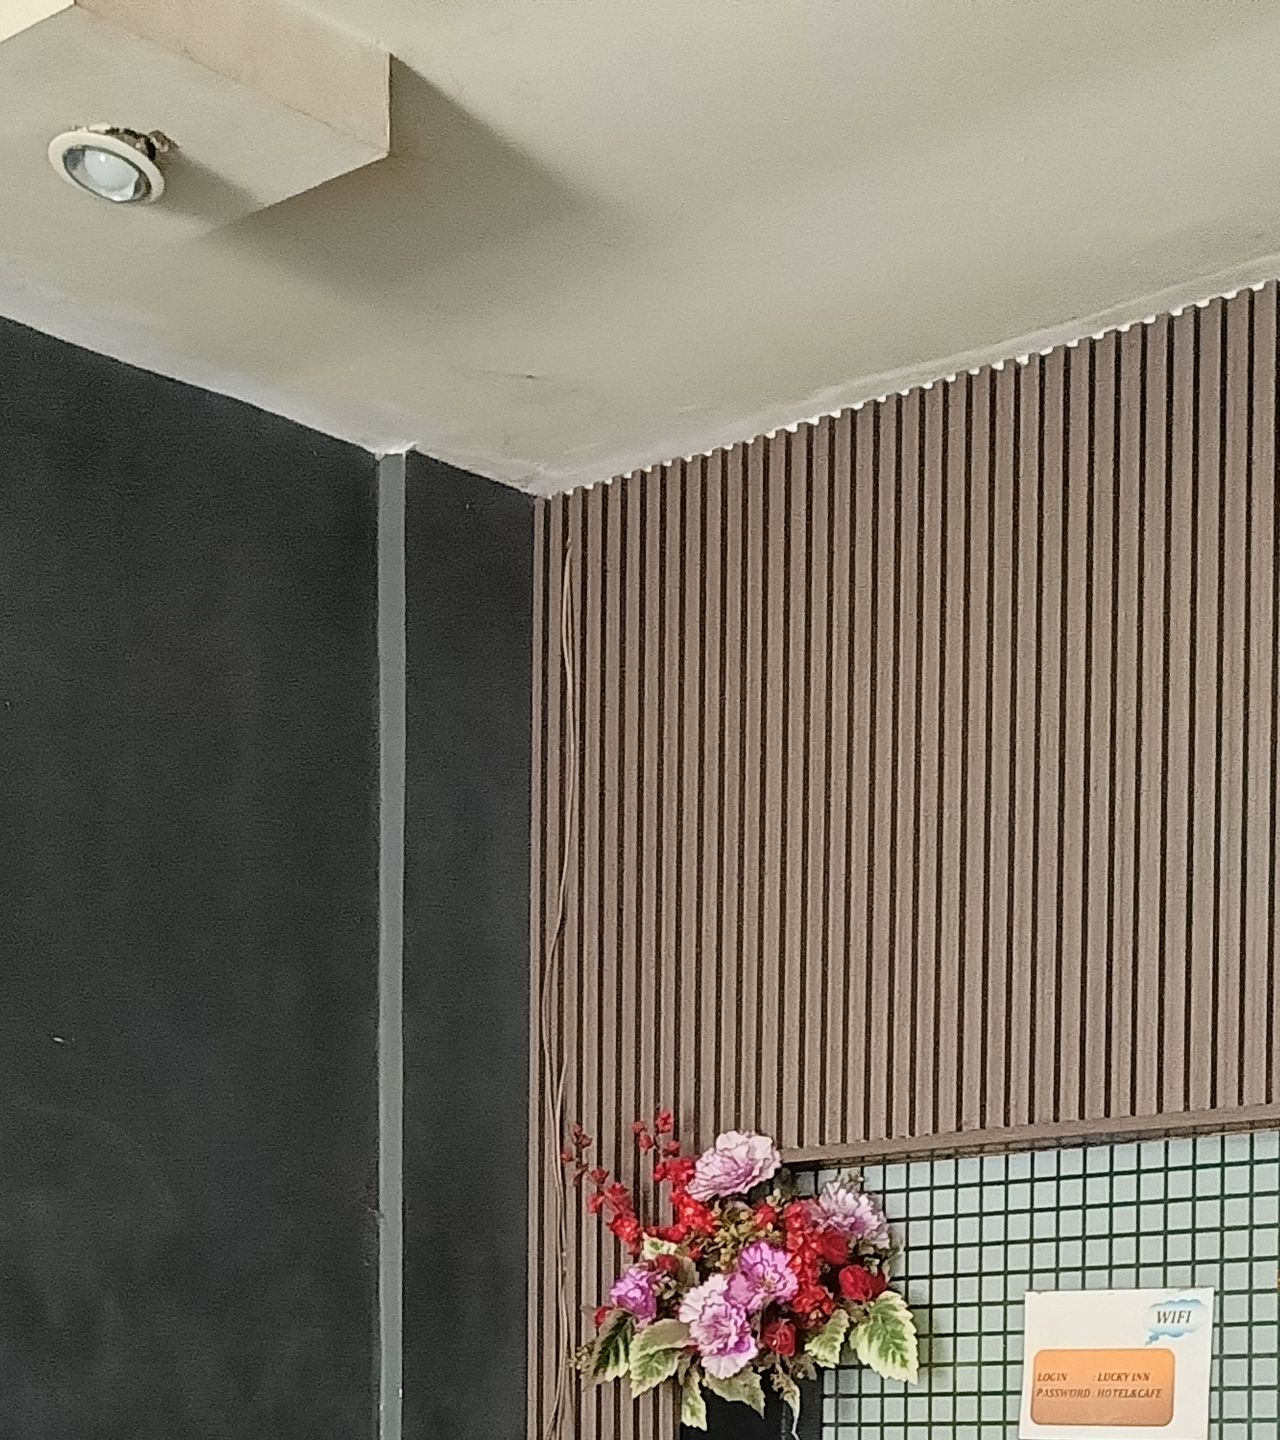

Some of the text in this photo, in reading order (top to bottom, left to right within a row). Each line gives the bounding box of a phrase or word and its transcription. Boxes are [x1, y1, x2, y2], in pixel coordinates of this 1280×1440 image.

[1157, 1310, 1192, 1324] WIFI
[1037, 1372, 1068, 1382] LOGIN
[1097, 1372, 1130, 1382] LUCKY
[1131, 1372, 1151, 1382] INN
